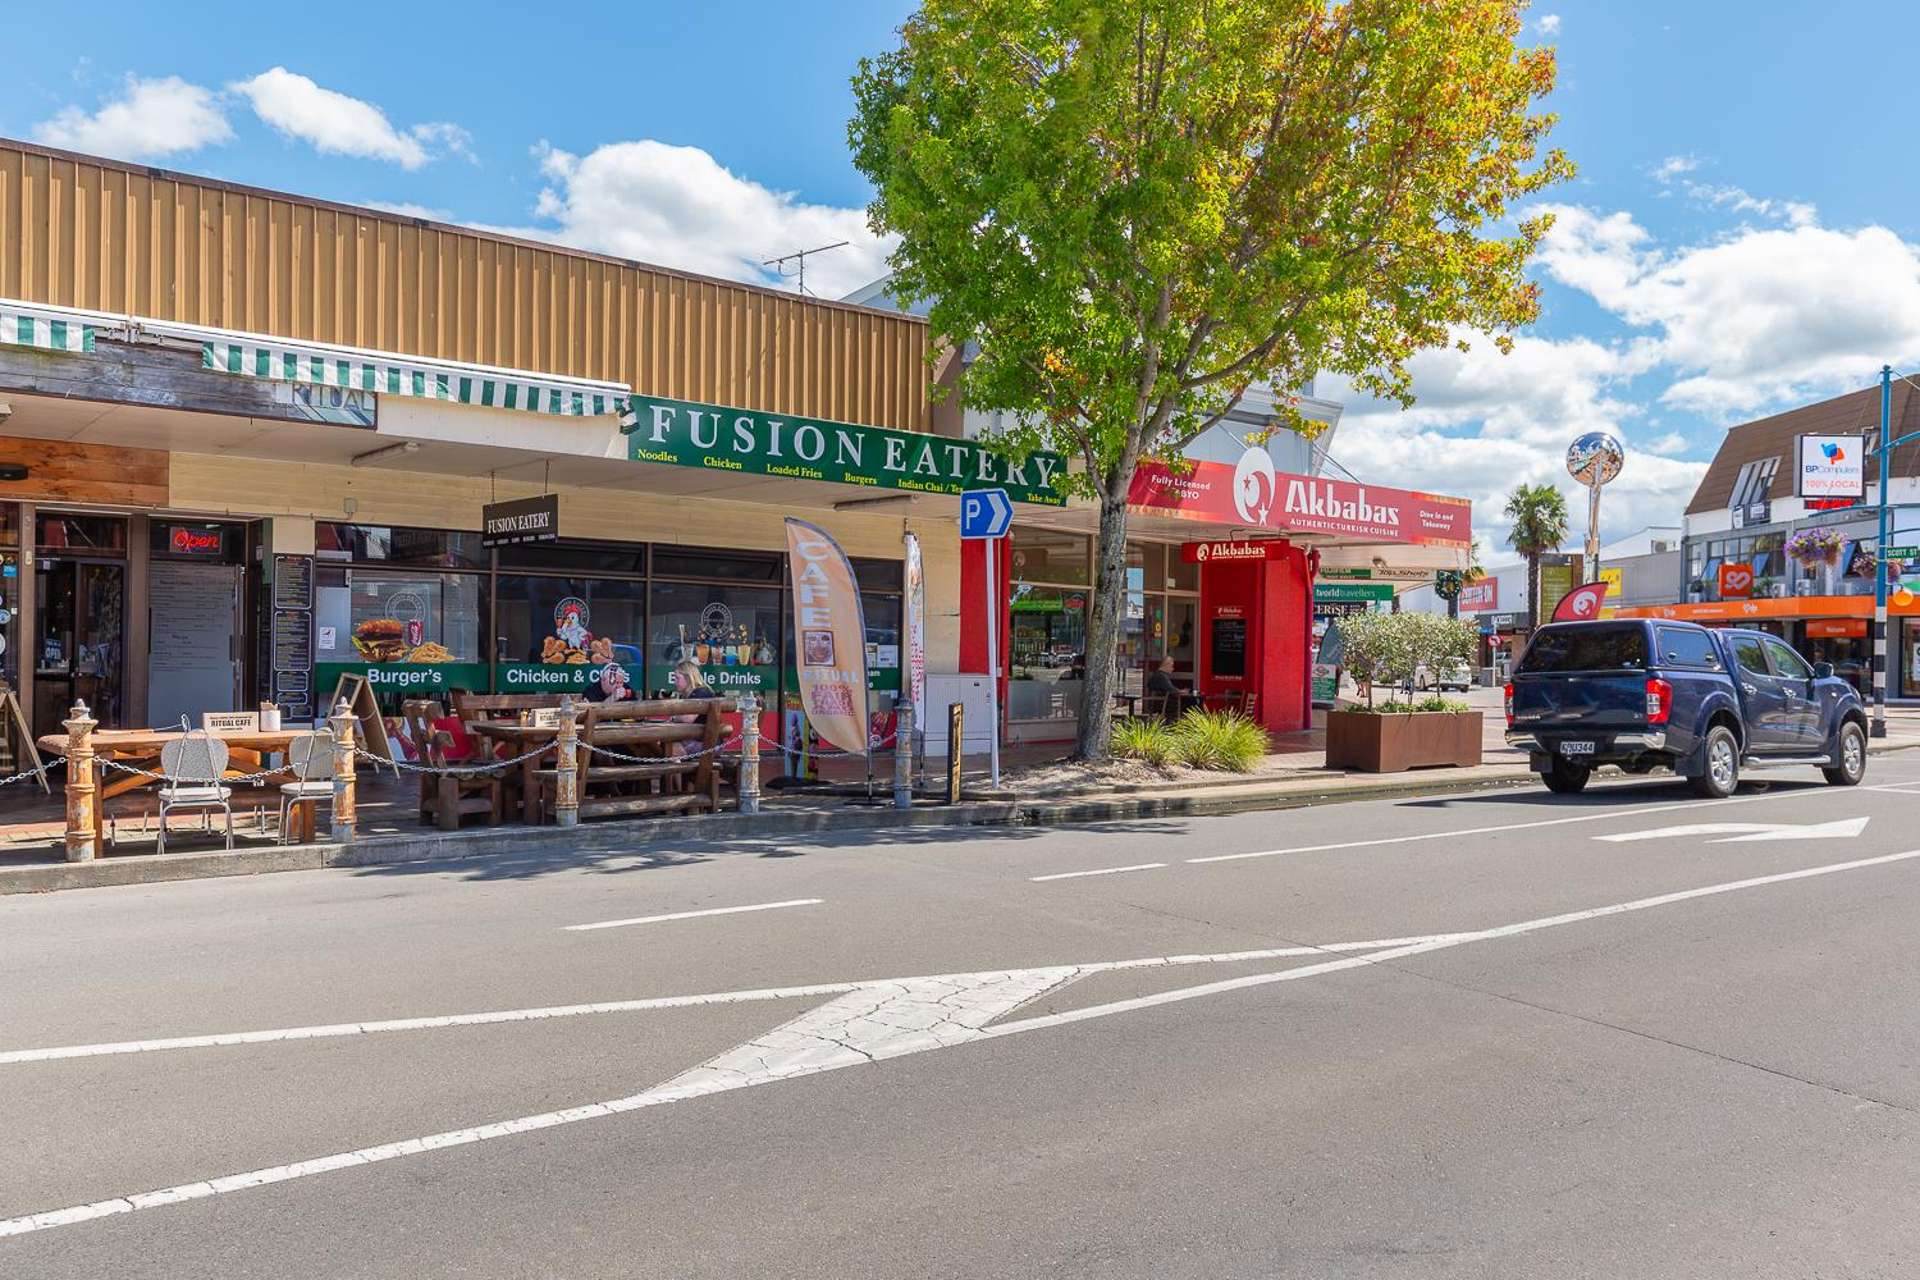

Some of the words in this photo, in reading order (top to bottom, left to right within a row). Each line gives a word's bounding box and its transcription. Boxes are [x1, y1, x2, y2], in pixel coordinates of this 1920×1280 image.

[649, 405, 865, 467] FUSION
[883, 437, 1055, 488] EATERY
[638, 449, 677, 463] Noodles
[704, 456, 742, 470] Chicken
[767, 464, 799, 477] Loaded
[801, 467, 823, 479] Fries
[844, 472, 877, 486] Burgers
[898, 479, 923, 490] Indian
[925, 482, 943, 493] Chai
[1151, 475, 1173, 487] Fully
[1174, 479, 1211, 490] Licensed
[1806, 480, 1828, 488] 100%
[1830, 480, 1860, 488] LOCAL
[1285, 480, 1400, 525] Akbabas
[966, 499, 980, 529] P
[488, 516, 517, 534] FUSION
[519, 512, 550, 530] EATERY
[1290, 518, 1335, 530] AUTHENTIC
[1336, 524, 1368, 533] TURKISH
[1370, 526, 1398, 537] CUISINE
[174, 531, 219, 550] Open
[1212, 542, 1265, 556] Akbabas
[797, 541, 833, 628] CAFE
[368, 669, 441, 686] Burger's
[507, 669, 568, 683] Chicken
[573, 669, 584, 682] &
[720, 672, 761, 684] Drinks
